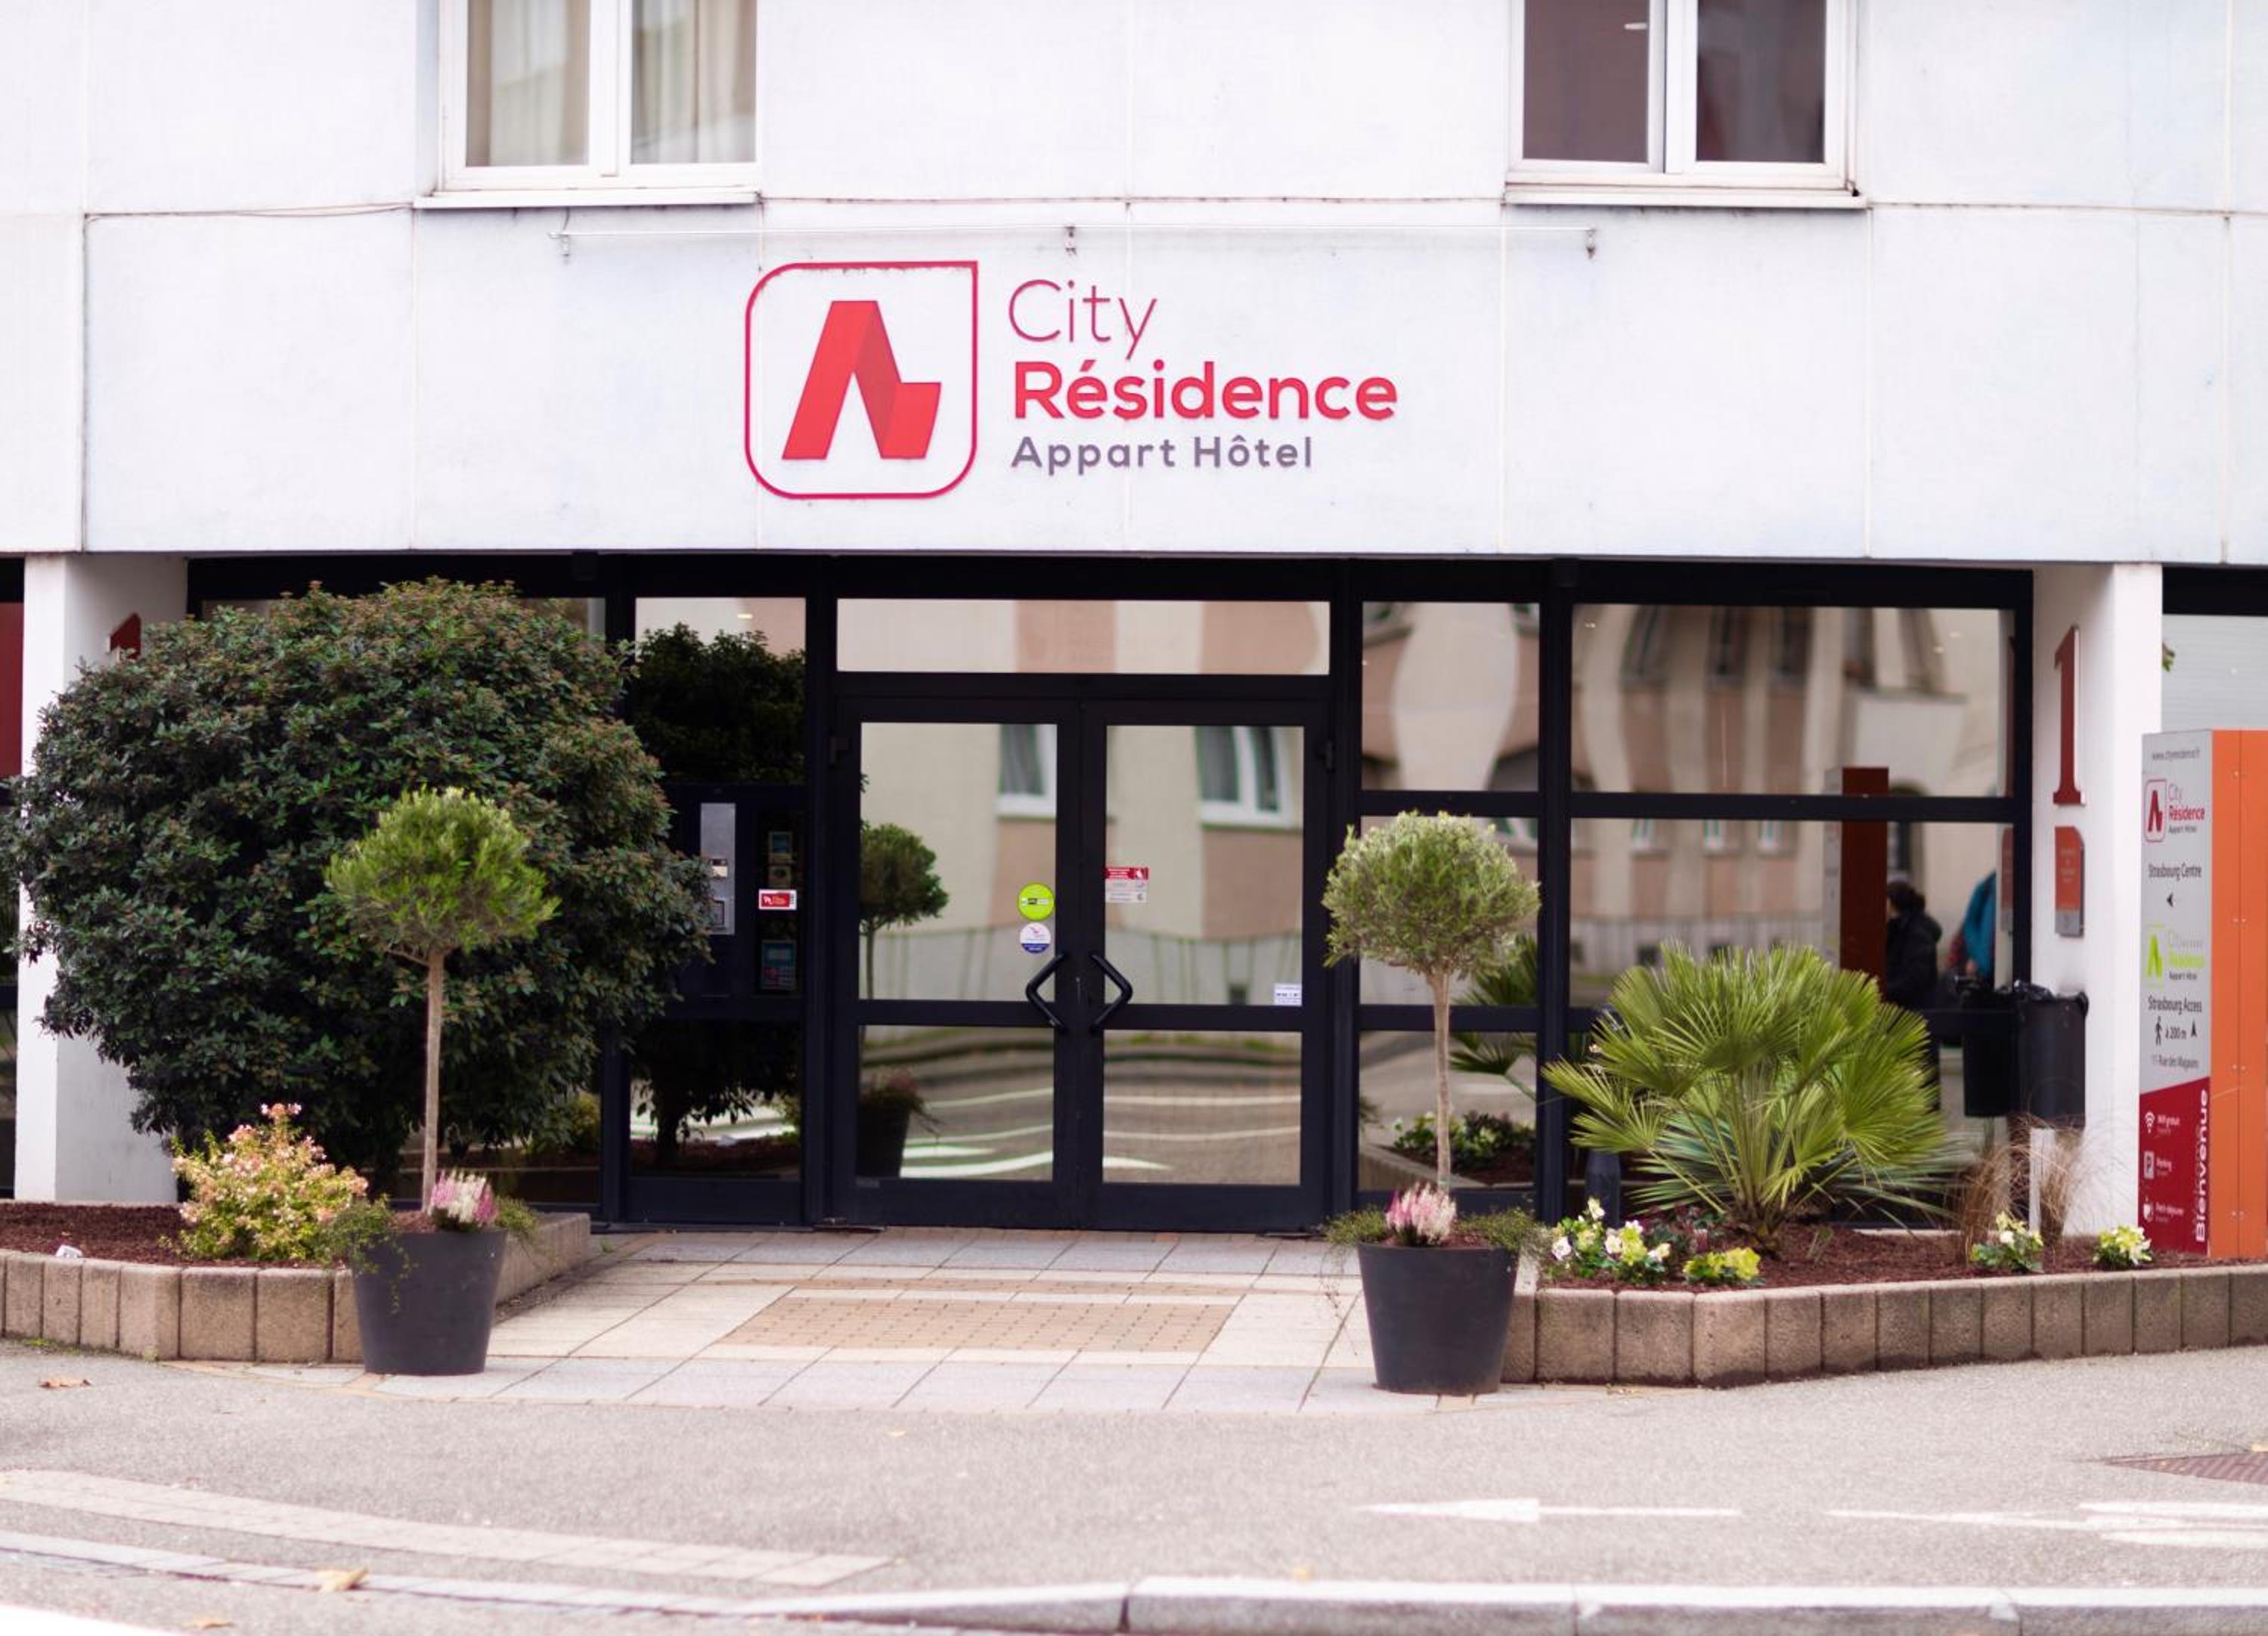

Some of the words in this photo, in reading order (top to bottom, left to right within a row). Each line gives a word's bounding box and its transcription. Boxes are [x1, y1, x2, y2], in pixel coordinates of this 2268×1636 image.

[1009, 279, 1160, 361] City
[1015, 359, 1398, 420] Résidence
[1011, 435, 1176, 476] Appart
[1193, 434, 1312, 468] Hôtel
[2149, 863, 2180, 882] Strasbourg
[2181, 862, 2201, 878] Centre
[2148, 993, 2182, 1015] Strasbourg
[2183, 996, 2202, 1014] Access
[2195, 1089, 2208, 1242] Bienvenue
